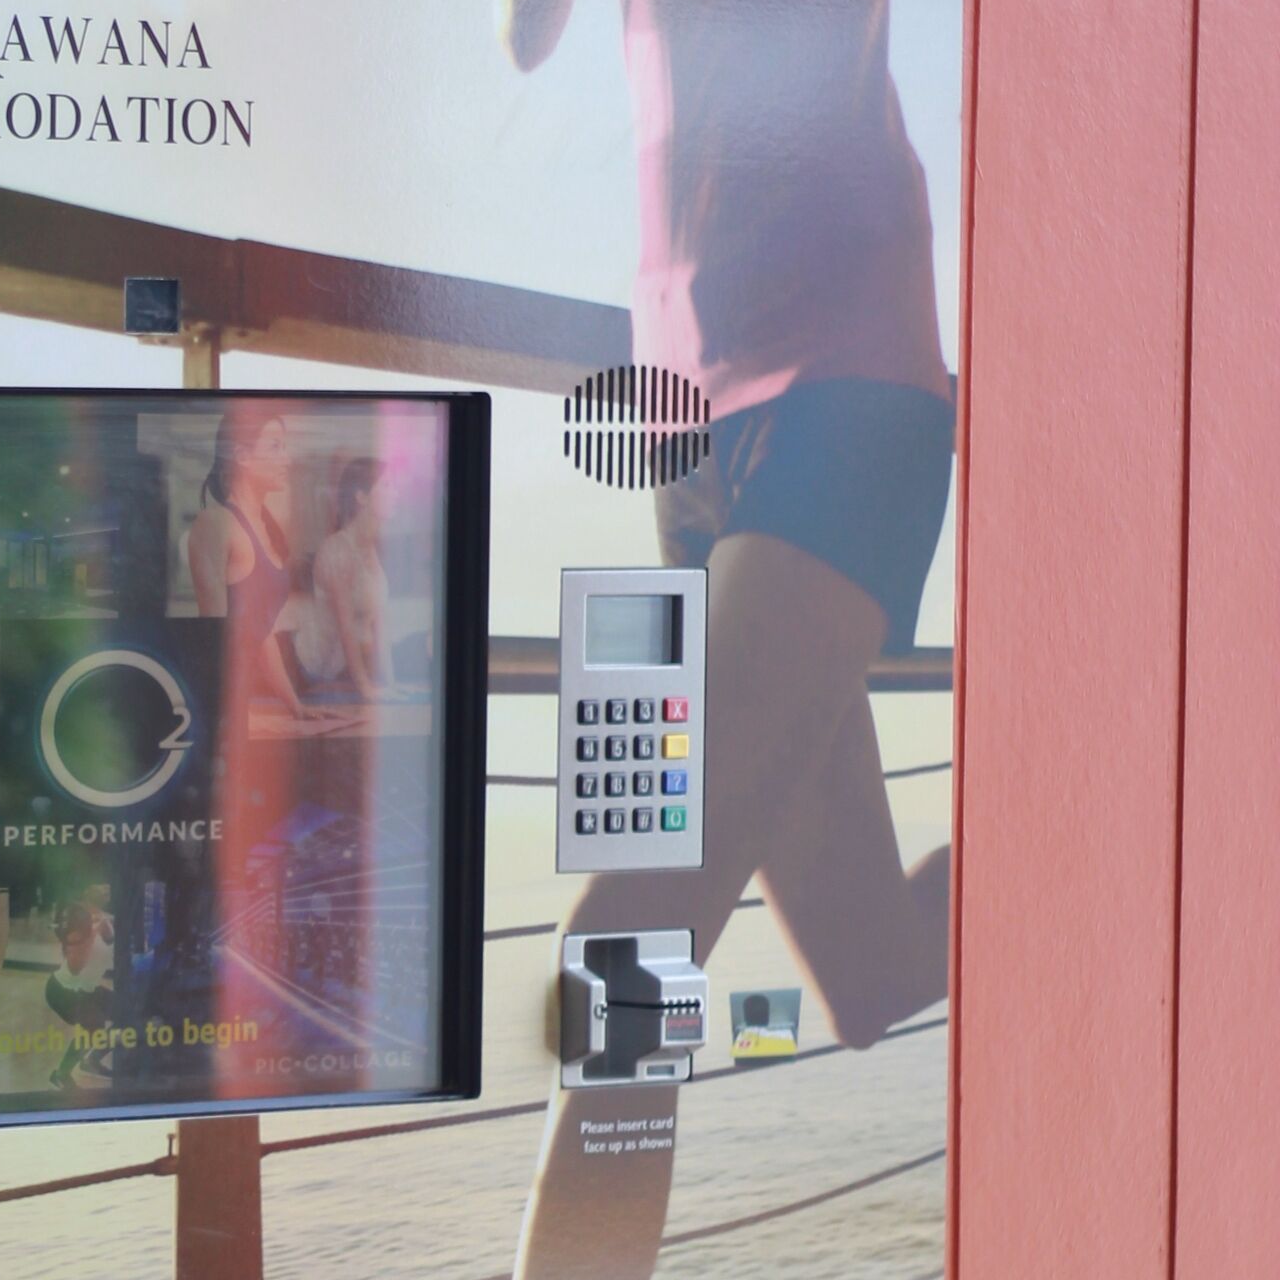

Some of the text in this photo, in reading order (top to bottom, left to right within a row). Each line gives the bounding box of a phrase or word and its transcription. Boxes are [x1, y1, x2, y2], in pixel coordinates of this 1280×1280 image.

[3, 819, 223, 848] PERFORMANCE
[74, 1022, 137, 1050] here
[145, 1022, 173, 1047] to
[183, 1015, 259, 1049] begin
[580, 1115, 674, 1134] Please insert card
[584, 1136, 673, 1155] face up as shown
